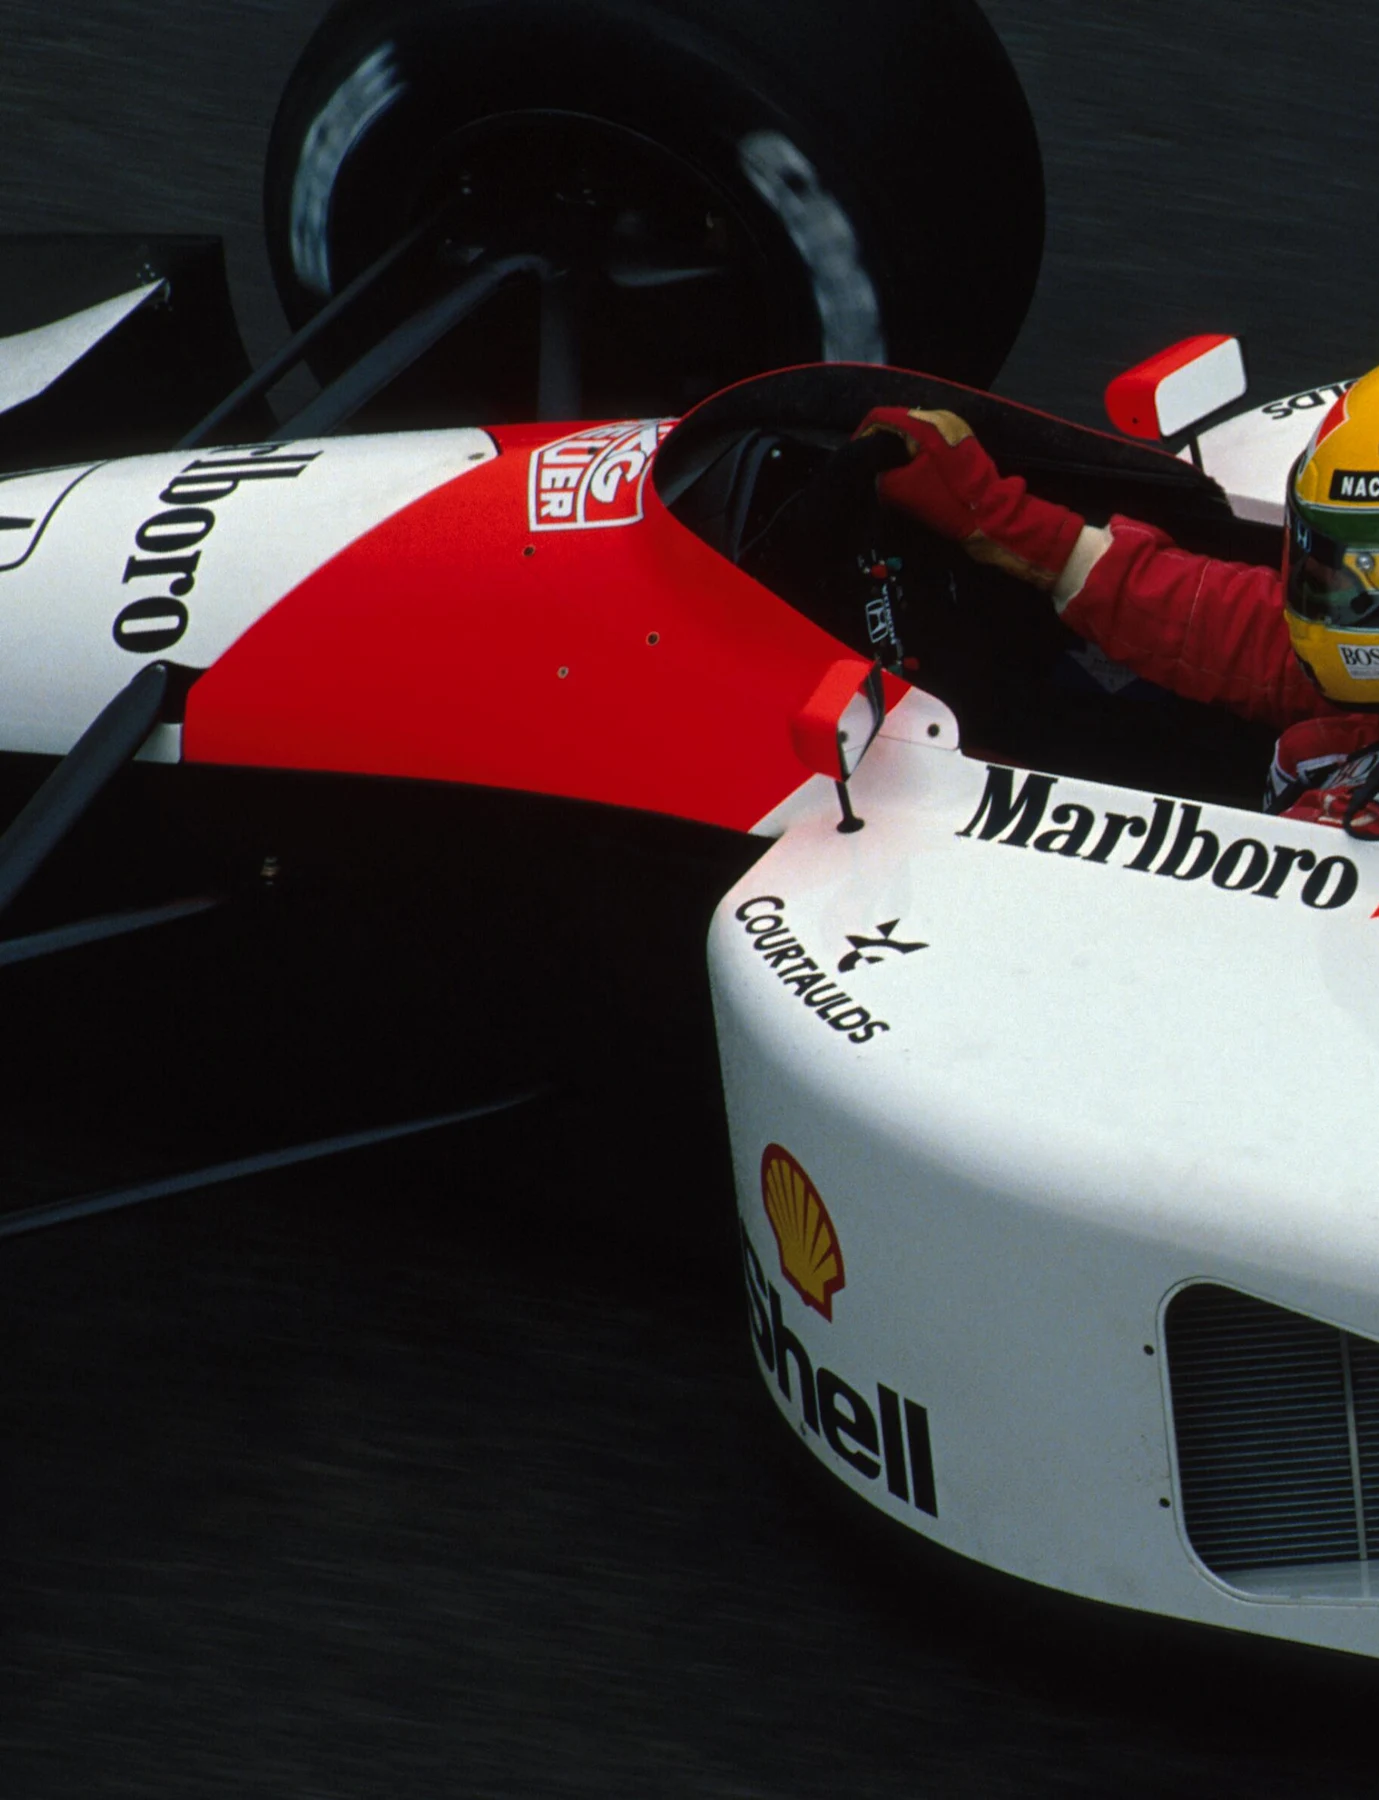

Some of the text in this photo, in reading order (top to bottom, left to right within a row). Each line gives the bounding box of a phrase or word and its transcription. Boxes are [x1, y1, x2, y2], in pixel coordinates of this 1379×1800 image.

[955, 764, 1359, 910] Marlboro
[735, 895, 890, 1044] COURTAULDS
[741, 1216, 939, 1519] Shell
